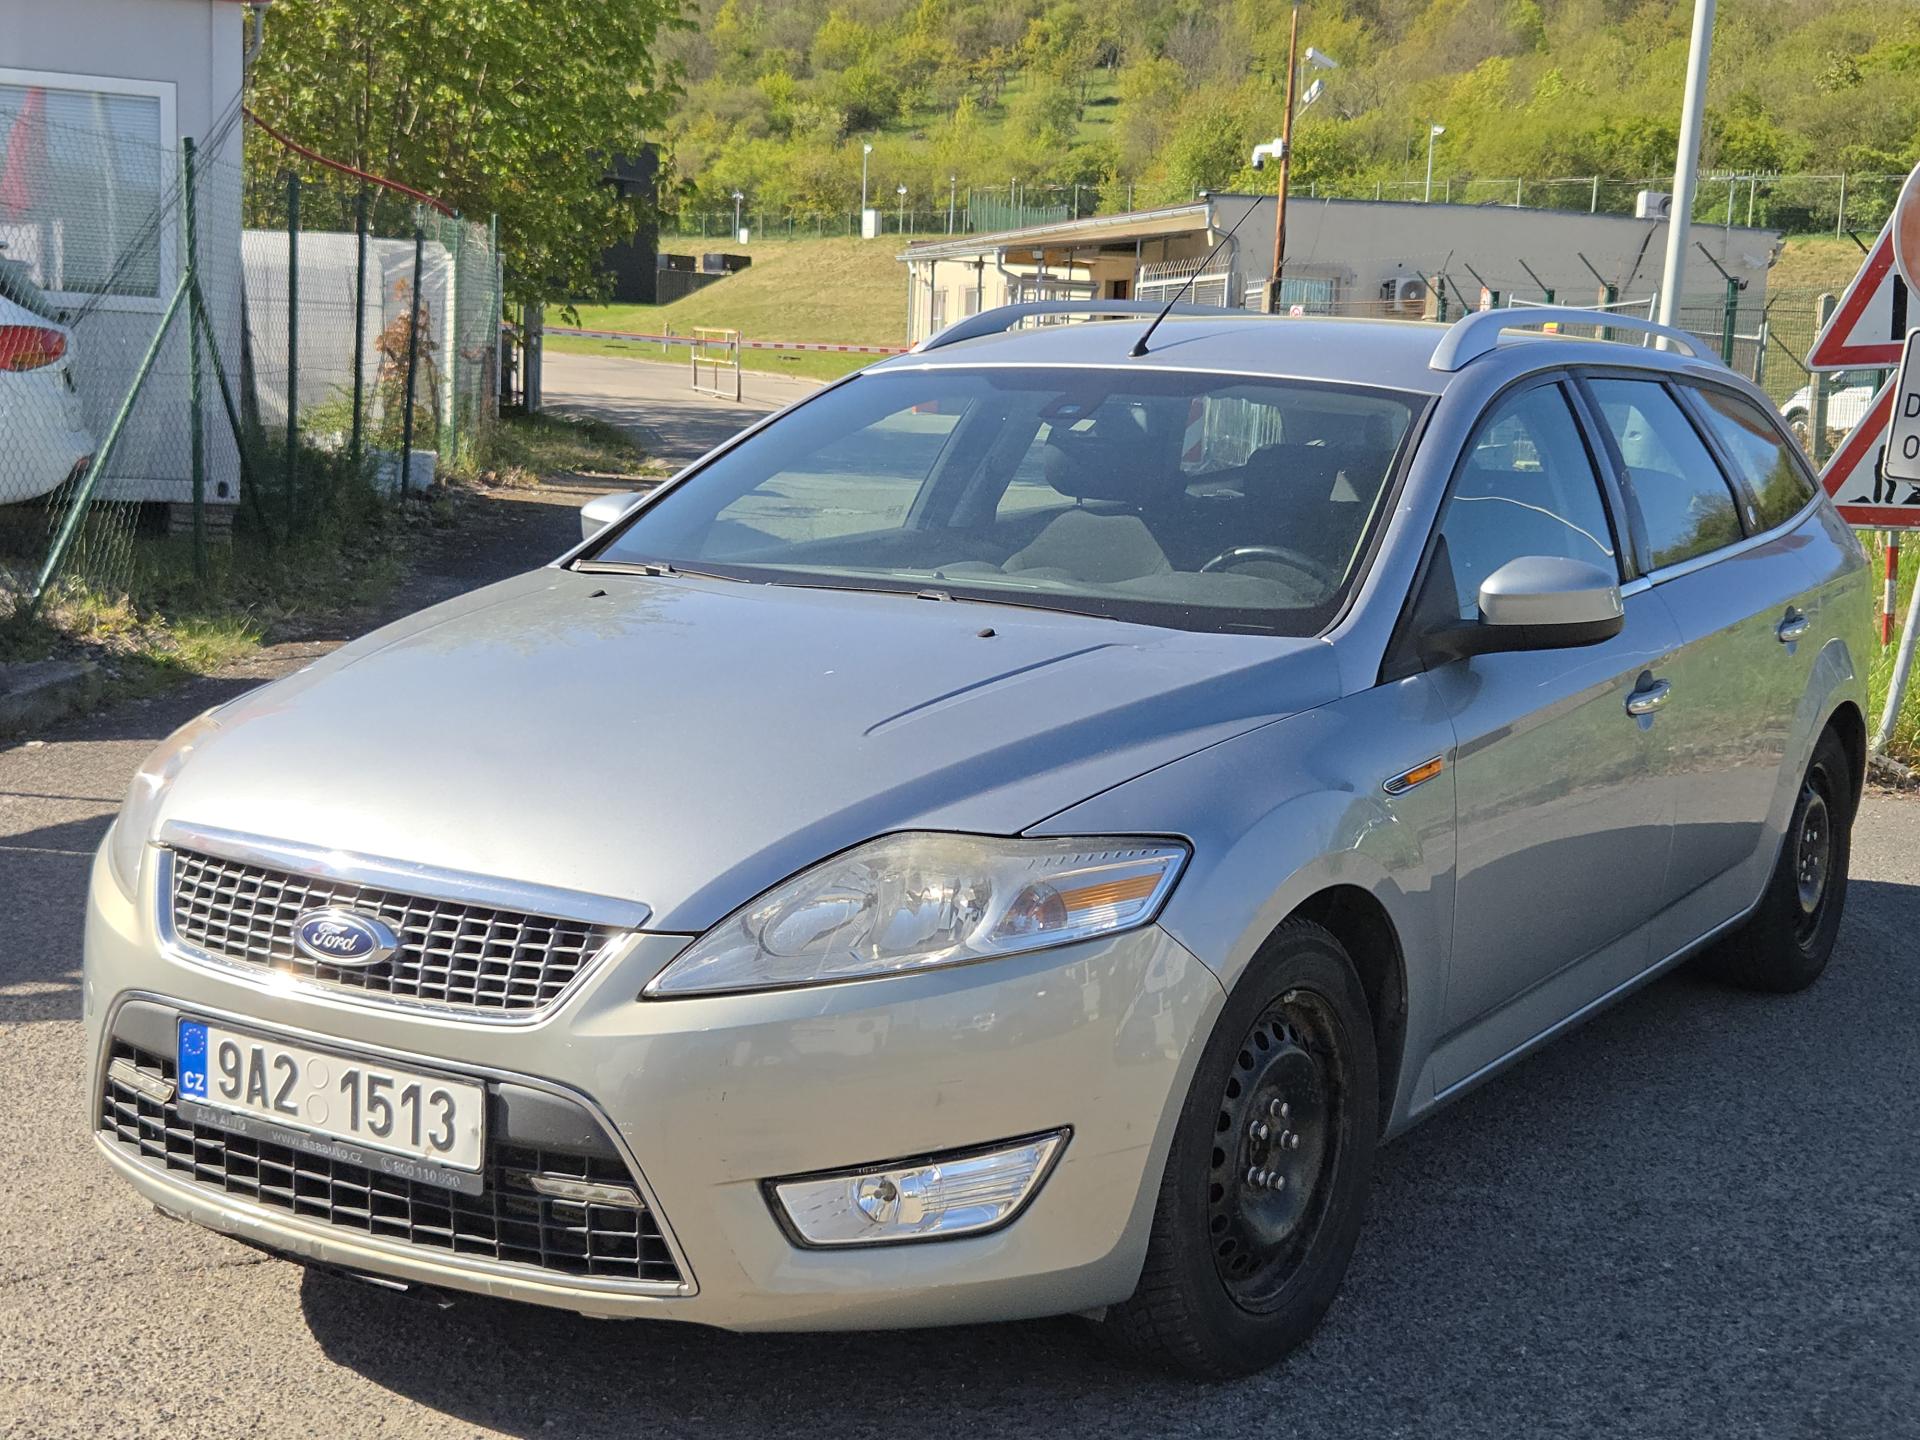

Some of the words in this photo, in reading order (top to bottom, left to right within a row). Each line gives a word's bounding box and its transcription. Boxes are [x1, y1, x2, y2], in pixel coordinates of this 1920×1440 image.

[312, 922, 359, 951] Ford
[184, 1071, 205, 1091] CZ
[218, 1040, 299, 1116] 9A2
[340, 1068, 456, 1152] 1513
